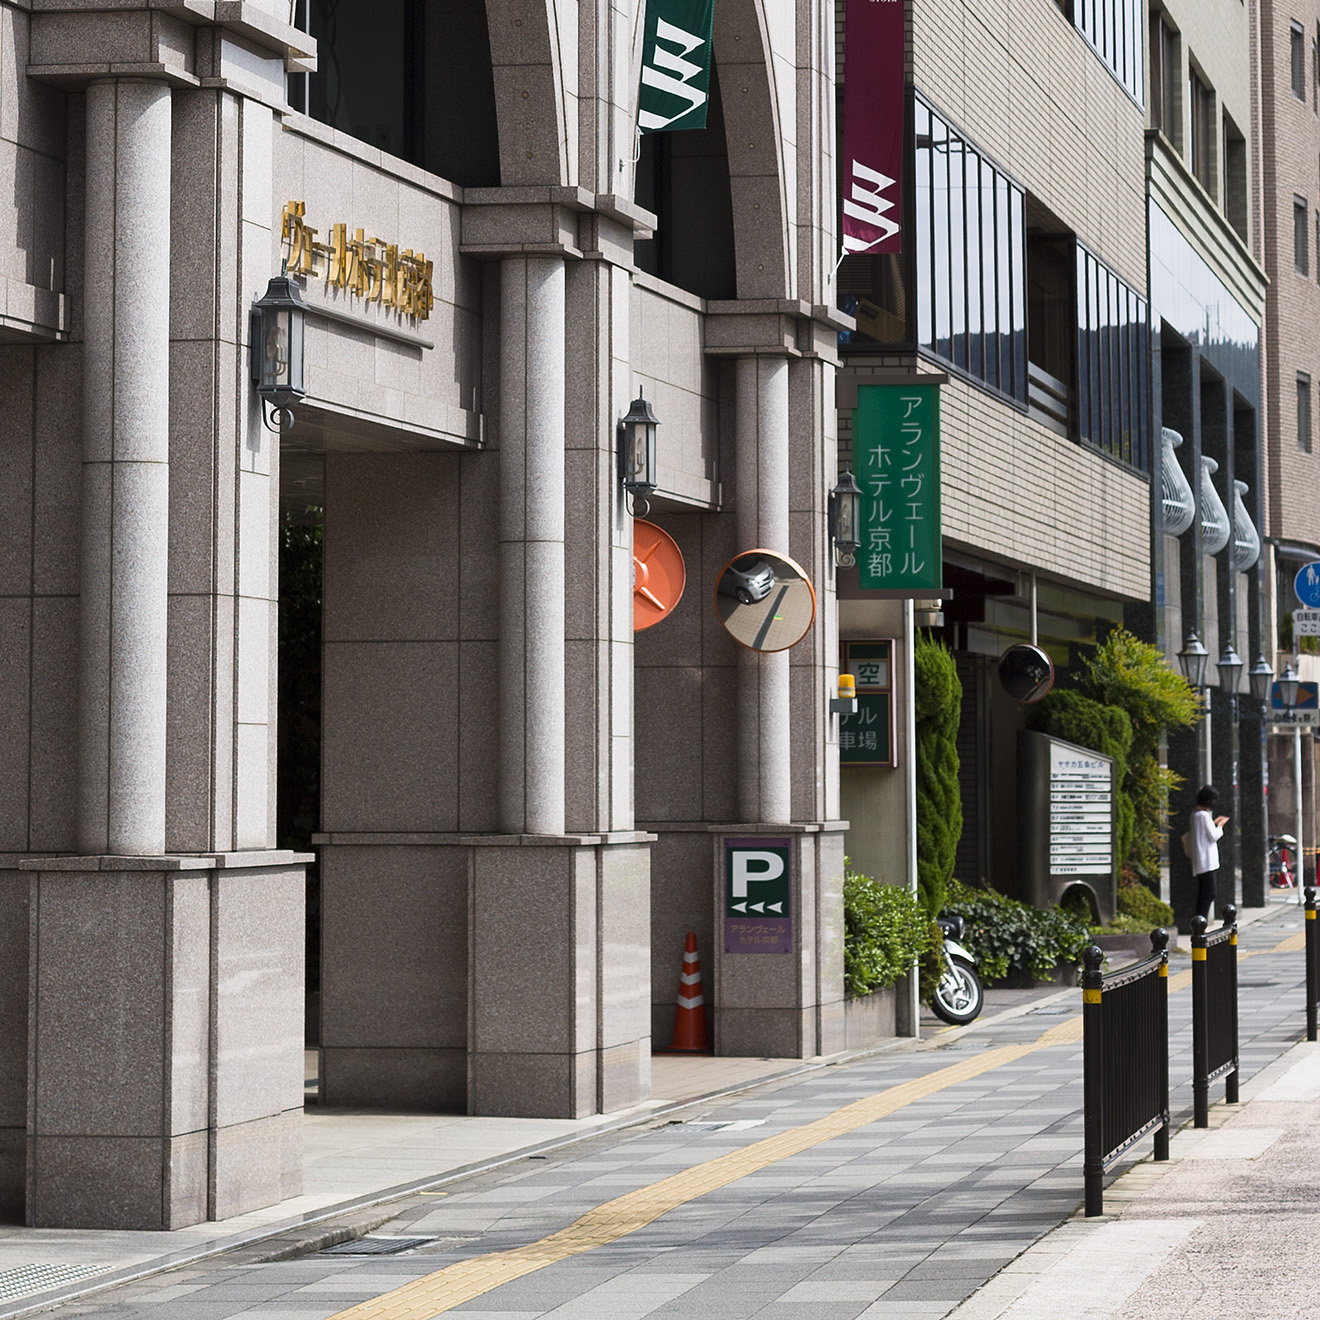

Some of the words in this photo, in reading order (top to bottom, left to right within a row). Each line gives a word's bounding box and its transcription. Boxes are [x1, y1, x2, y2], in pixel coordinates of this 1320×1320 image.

[900, 397, 925, 575] アランヴェール
[867, 444, 893, 577] ホテル京都
[858, 662, 880, 685] 空
[732, 851, 784, 897] P
[730, 924, 786, 934] アランヴェール
